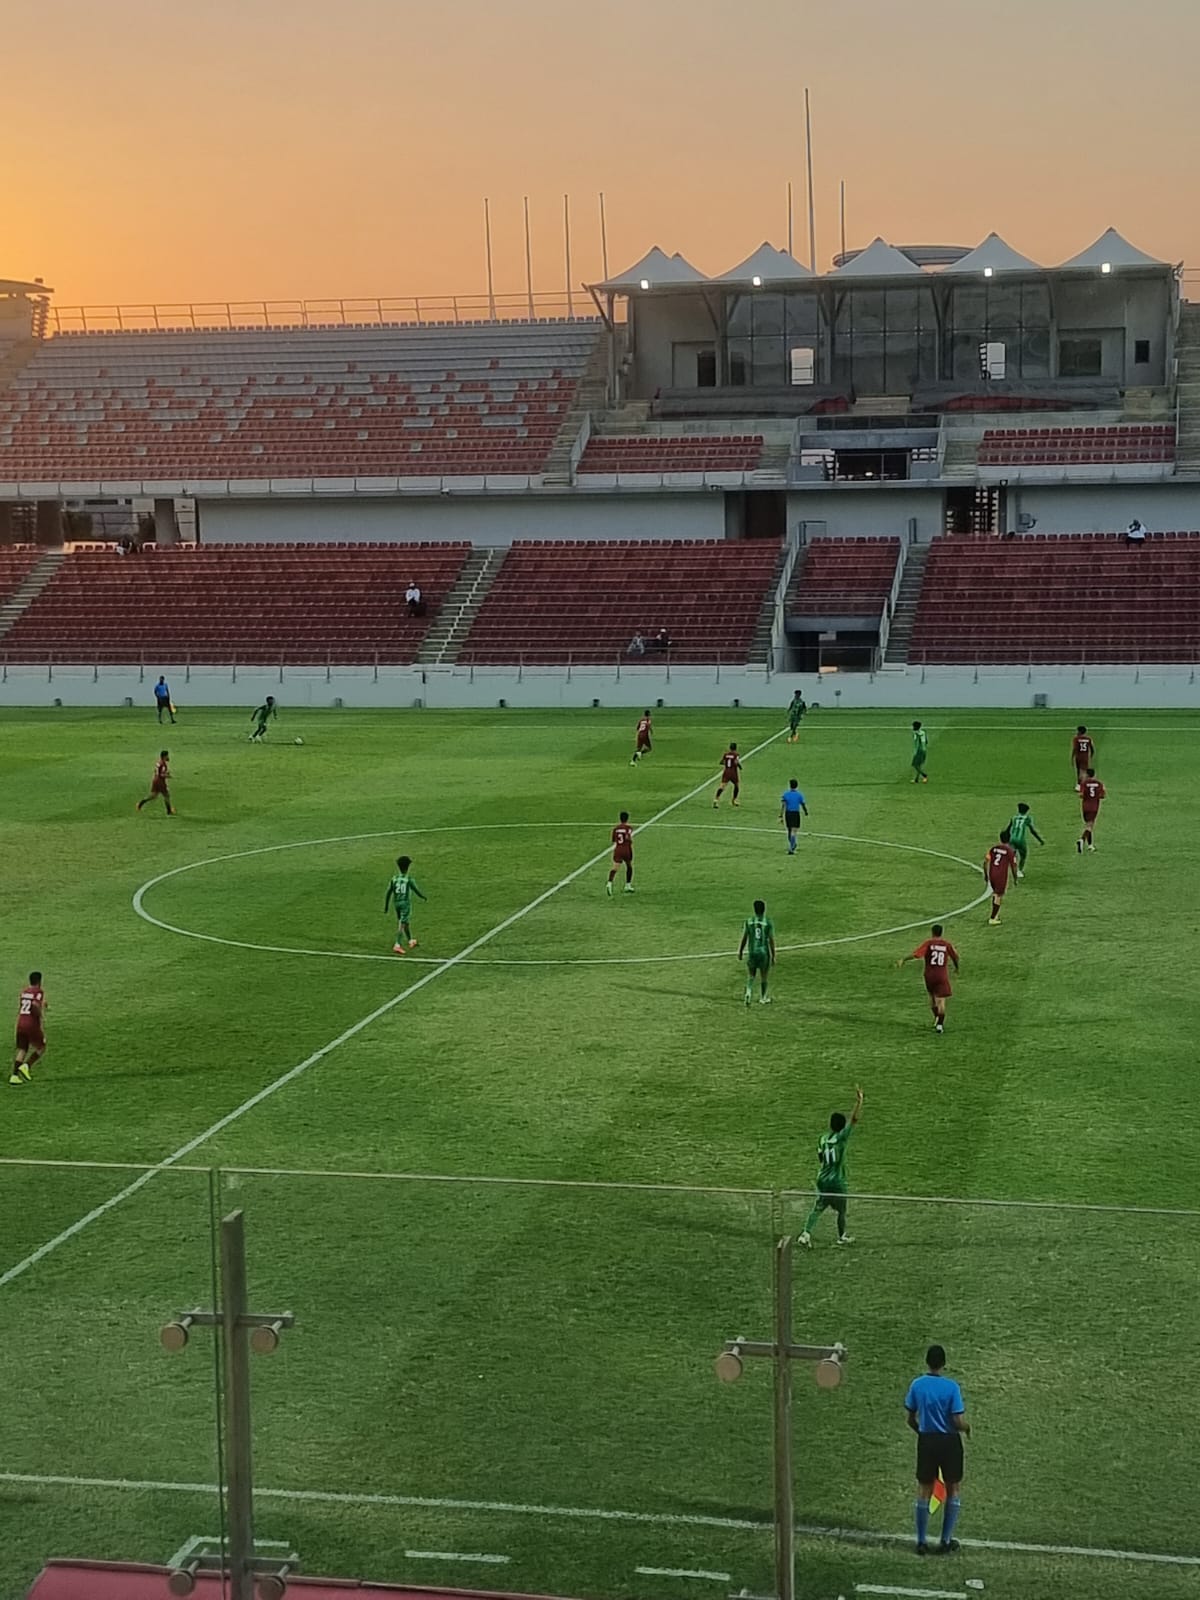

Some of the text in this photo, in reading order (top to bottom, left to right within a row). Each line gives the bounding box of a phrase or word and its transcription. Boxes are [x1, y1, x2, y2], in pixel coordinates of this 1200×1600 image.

[1089, 788, 1096, 798] 5
[617, 833, 624, 844] 3
[993, 853, 1001, 866] 2
[930, 950, 945, 966] 28
